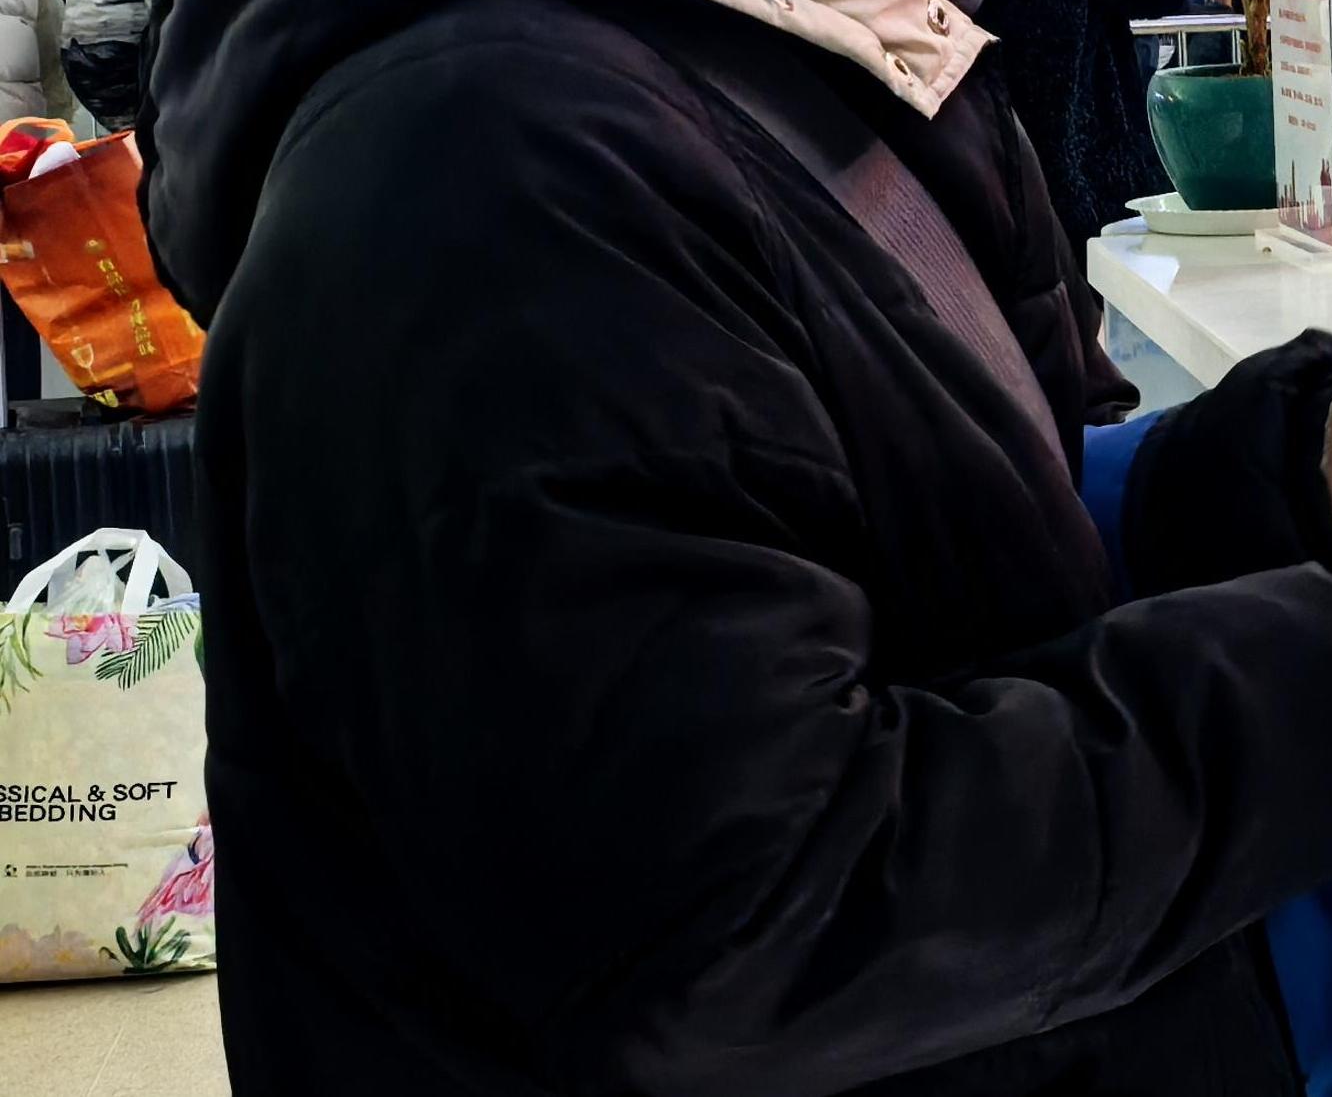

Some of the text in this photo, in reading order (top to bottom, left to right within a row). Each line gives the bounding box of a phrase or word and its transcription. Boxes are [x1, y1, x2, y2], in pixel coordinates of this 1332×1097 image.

[87, 784, 106, 802] &
[113, 781, 178, 802] SOFT
[0, 803, 116, 823] BEDDING
